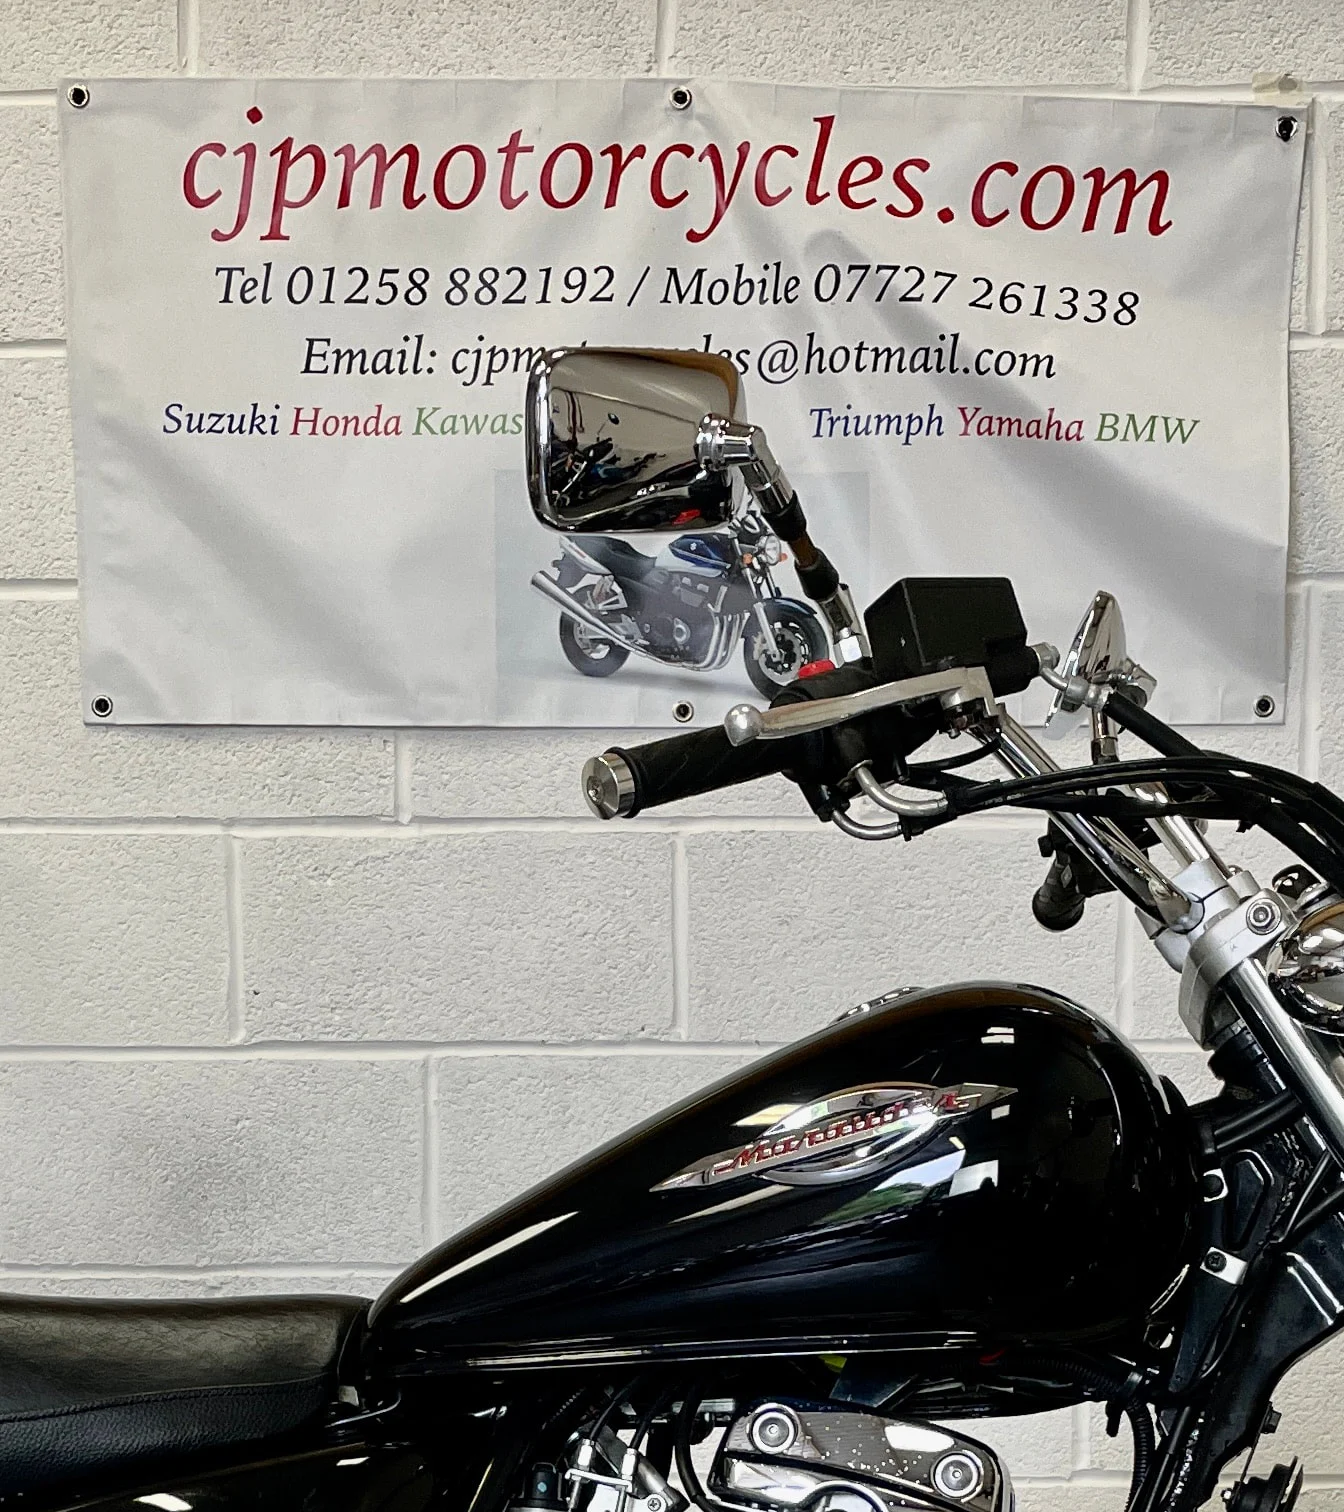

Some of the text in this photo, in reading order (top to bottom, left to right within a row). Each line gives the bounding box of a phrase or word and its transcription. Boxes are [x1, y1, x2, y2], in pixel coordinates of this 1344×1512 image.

[182, 106, 1173, 243] cjpmotorcycles.com
[214, 262, 1140, 327] Tel 01258 882192 / Mobile 07727 261338
[301, 332, 1056, 387] Email: cjpms@hotmail.com
[163, 402, 1201, 446] Suzuki Honda Kawas Triumph Yamaha BMW
